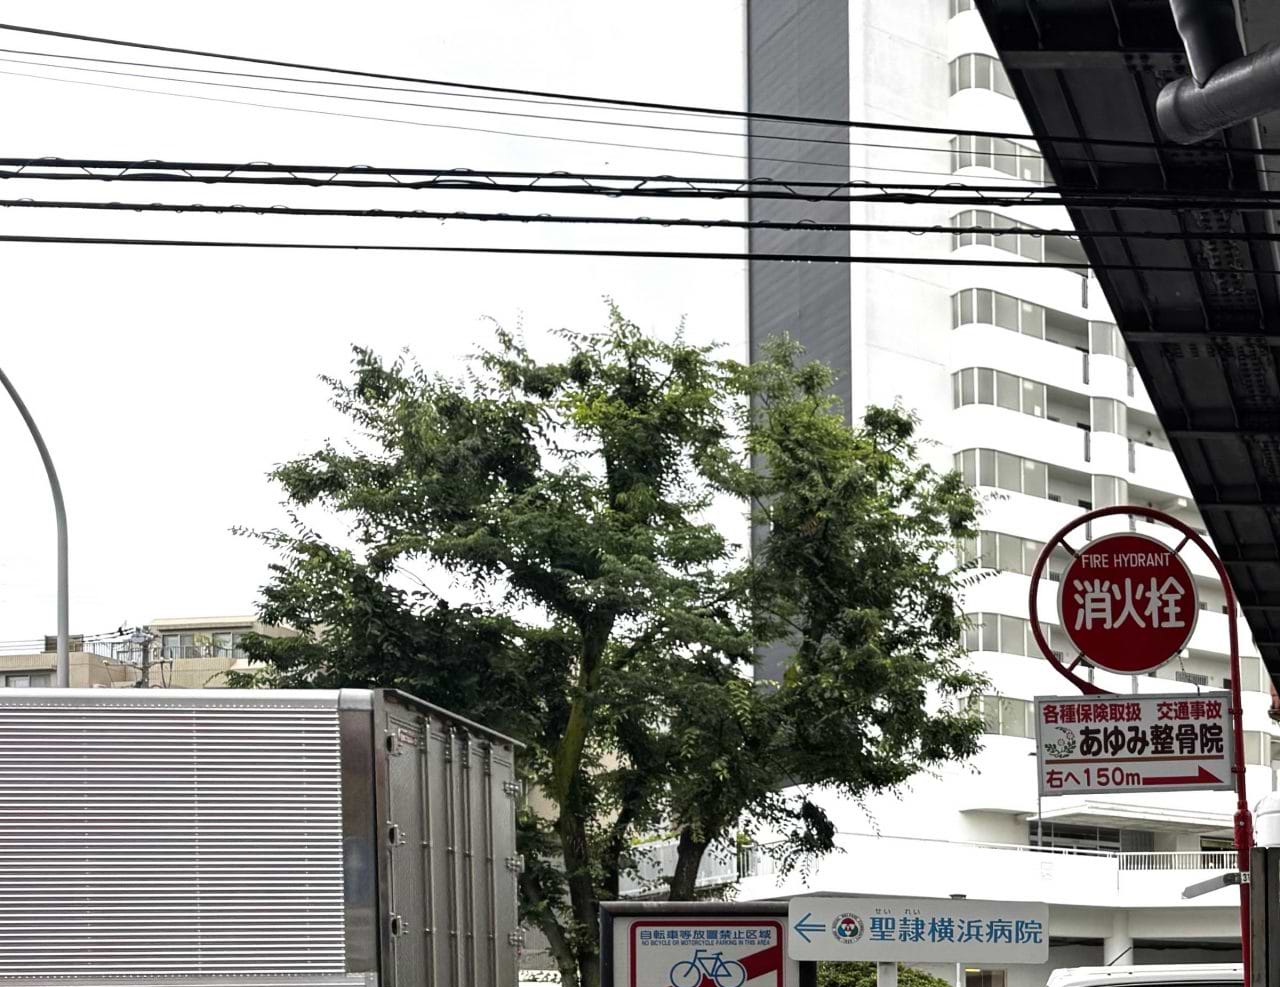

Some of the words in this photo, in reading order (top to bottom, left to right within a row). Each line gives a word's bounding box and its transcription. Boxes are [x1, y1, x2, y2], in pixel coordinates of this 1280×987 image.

[1081, 554, 1109, 568] FIRE
[1113, 552, 1171, 568] HYDRANT
[1073, 576, 1186, 631] 消火栓
[1042, 703, 1141, 724] 各種保険取扱
[1156, 701, 1222, 721] 交通事故
[1079, 723, 1224, 756] あゆみ整骨院
[1046, 767, 1141, 789] 右へ150m
[639, 929, 772, 940] 自転車等放置禁止区域
[869, 916, 1043, 944] 聖隷横浜病院
